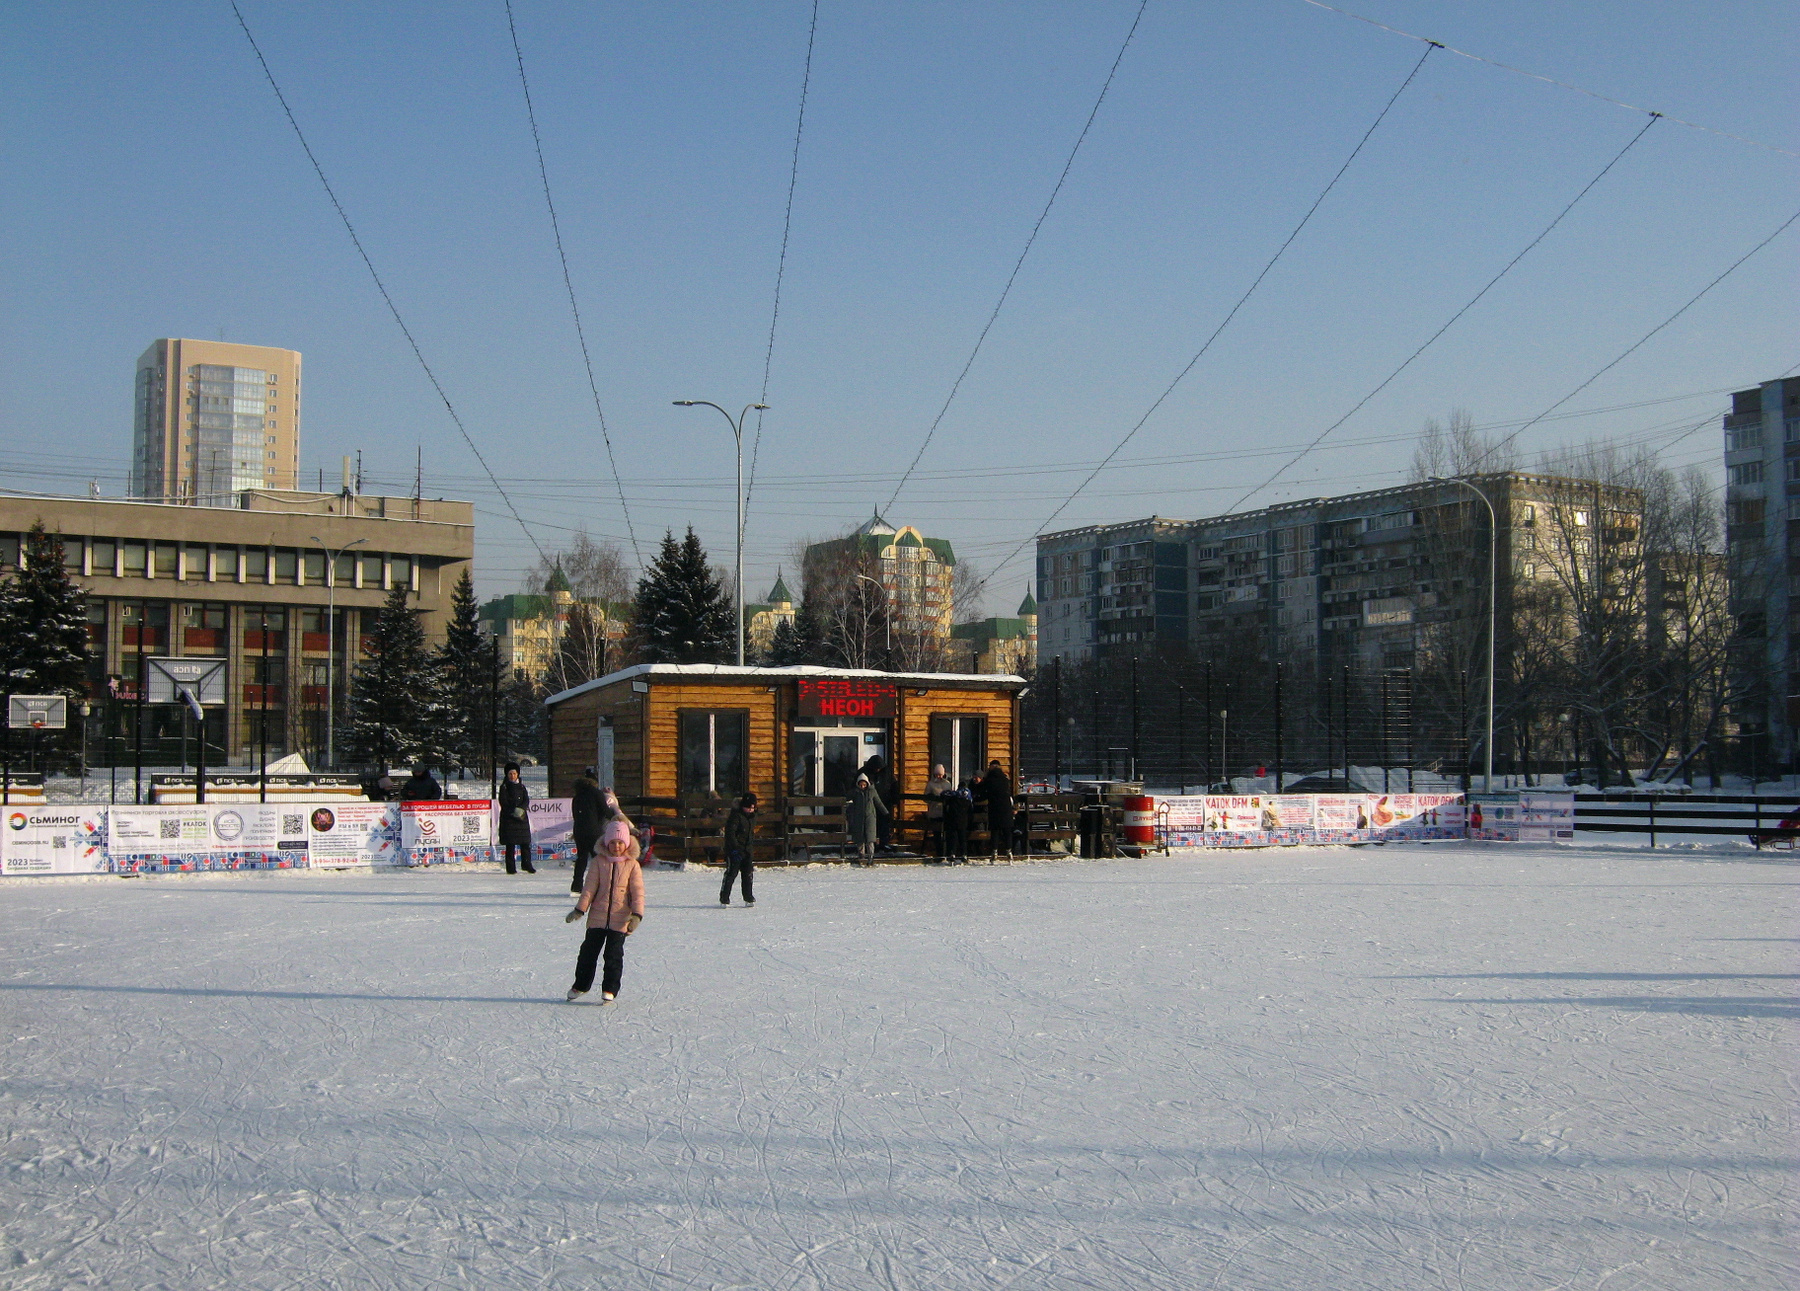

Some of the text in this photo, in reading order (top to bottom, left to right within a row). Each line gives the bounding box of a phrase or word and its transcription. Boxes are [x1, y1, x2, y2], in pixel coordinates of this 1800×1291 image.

[821, 699, 875, 716] НЕОН
[1205, 797, 1230, 809] КАТОК
[1418, 796, 1439, 806] КАТОК
[29, 816, 80, 824] СЬМИНОГ
